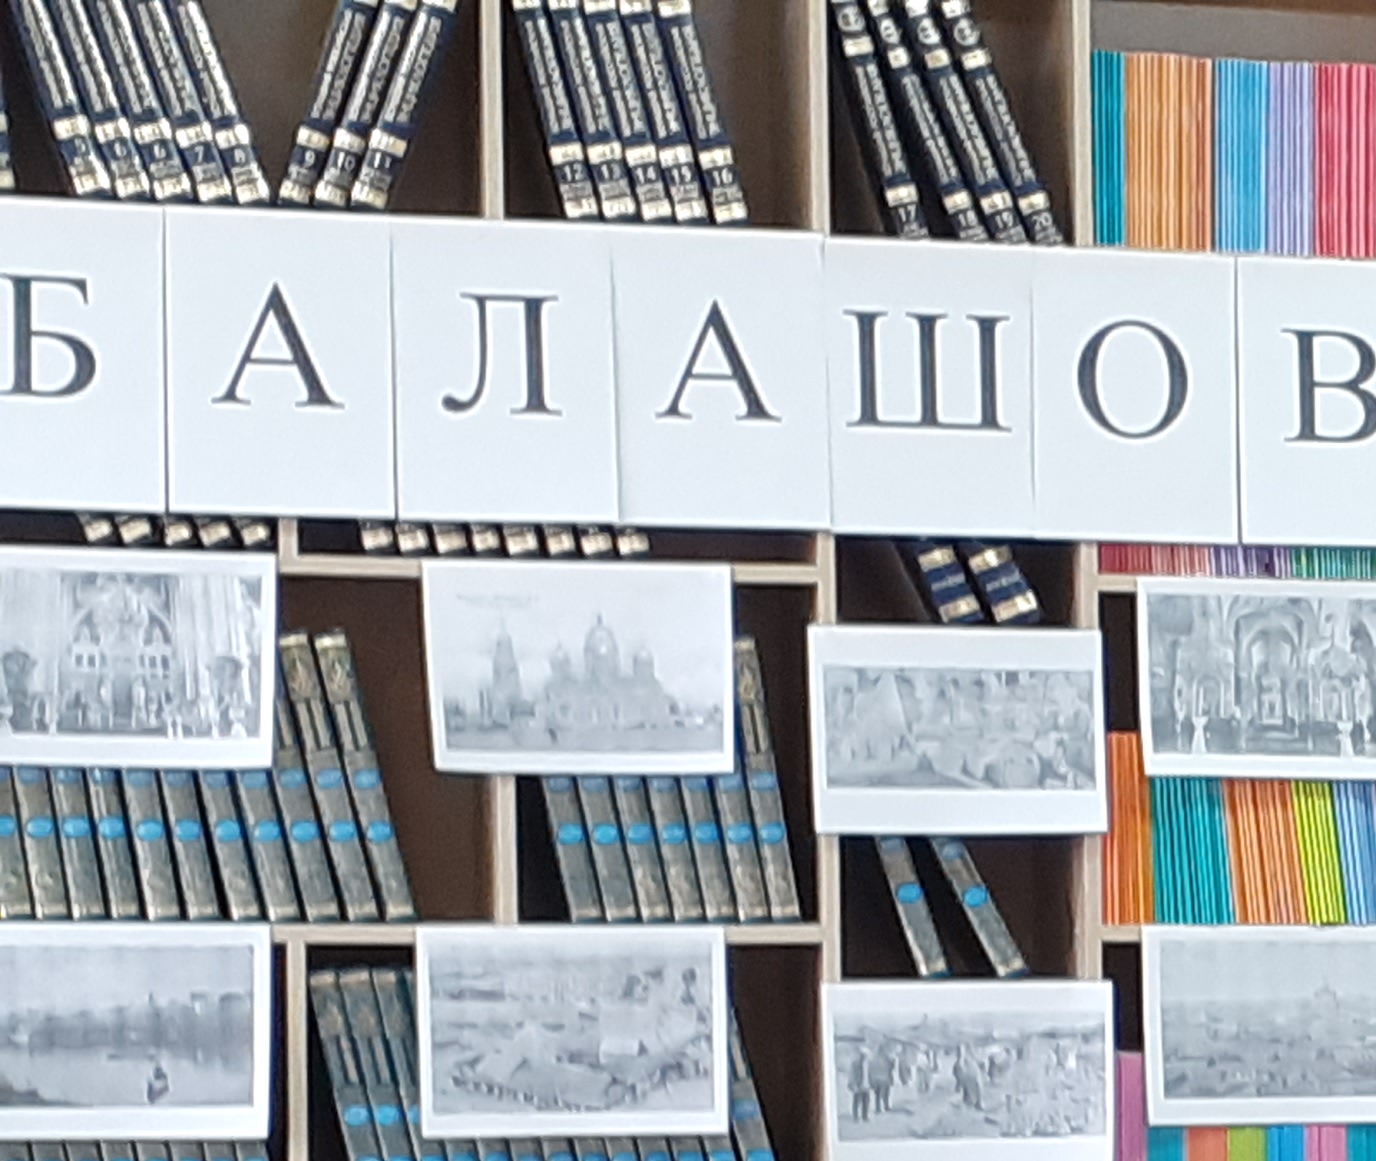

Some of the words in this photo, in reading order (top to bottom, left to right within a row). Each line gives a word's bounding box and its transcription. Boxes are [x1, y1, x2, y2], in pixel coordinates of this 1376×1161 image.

[897, 205, 918, 223] 17
[994, 211, 1015, 229] 19
[1032, 211, 1053, 229] 20
